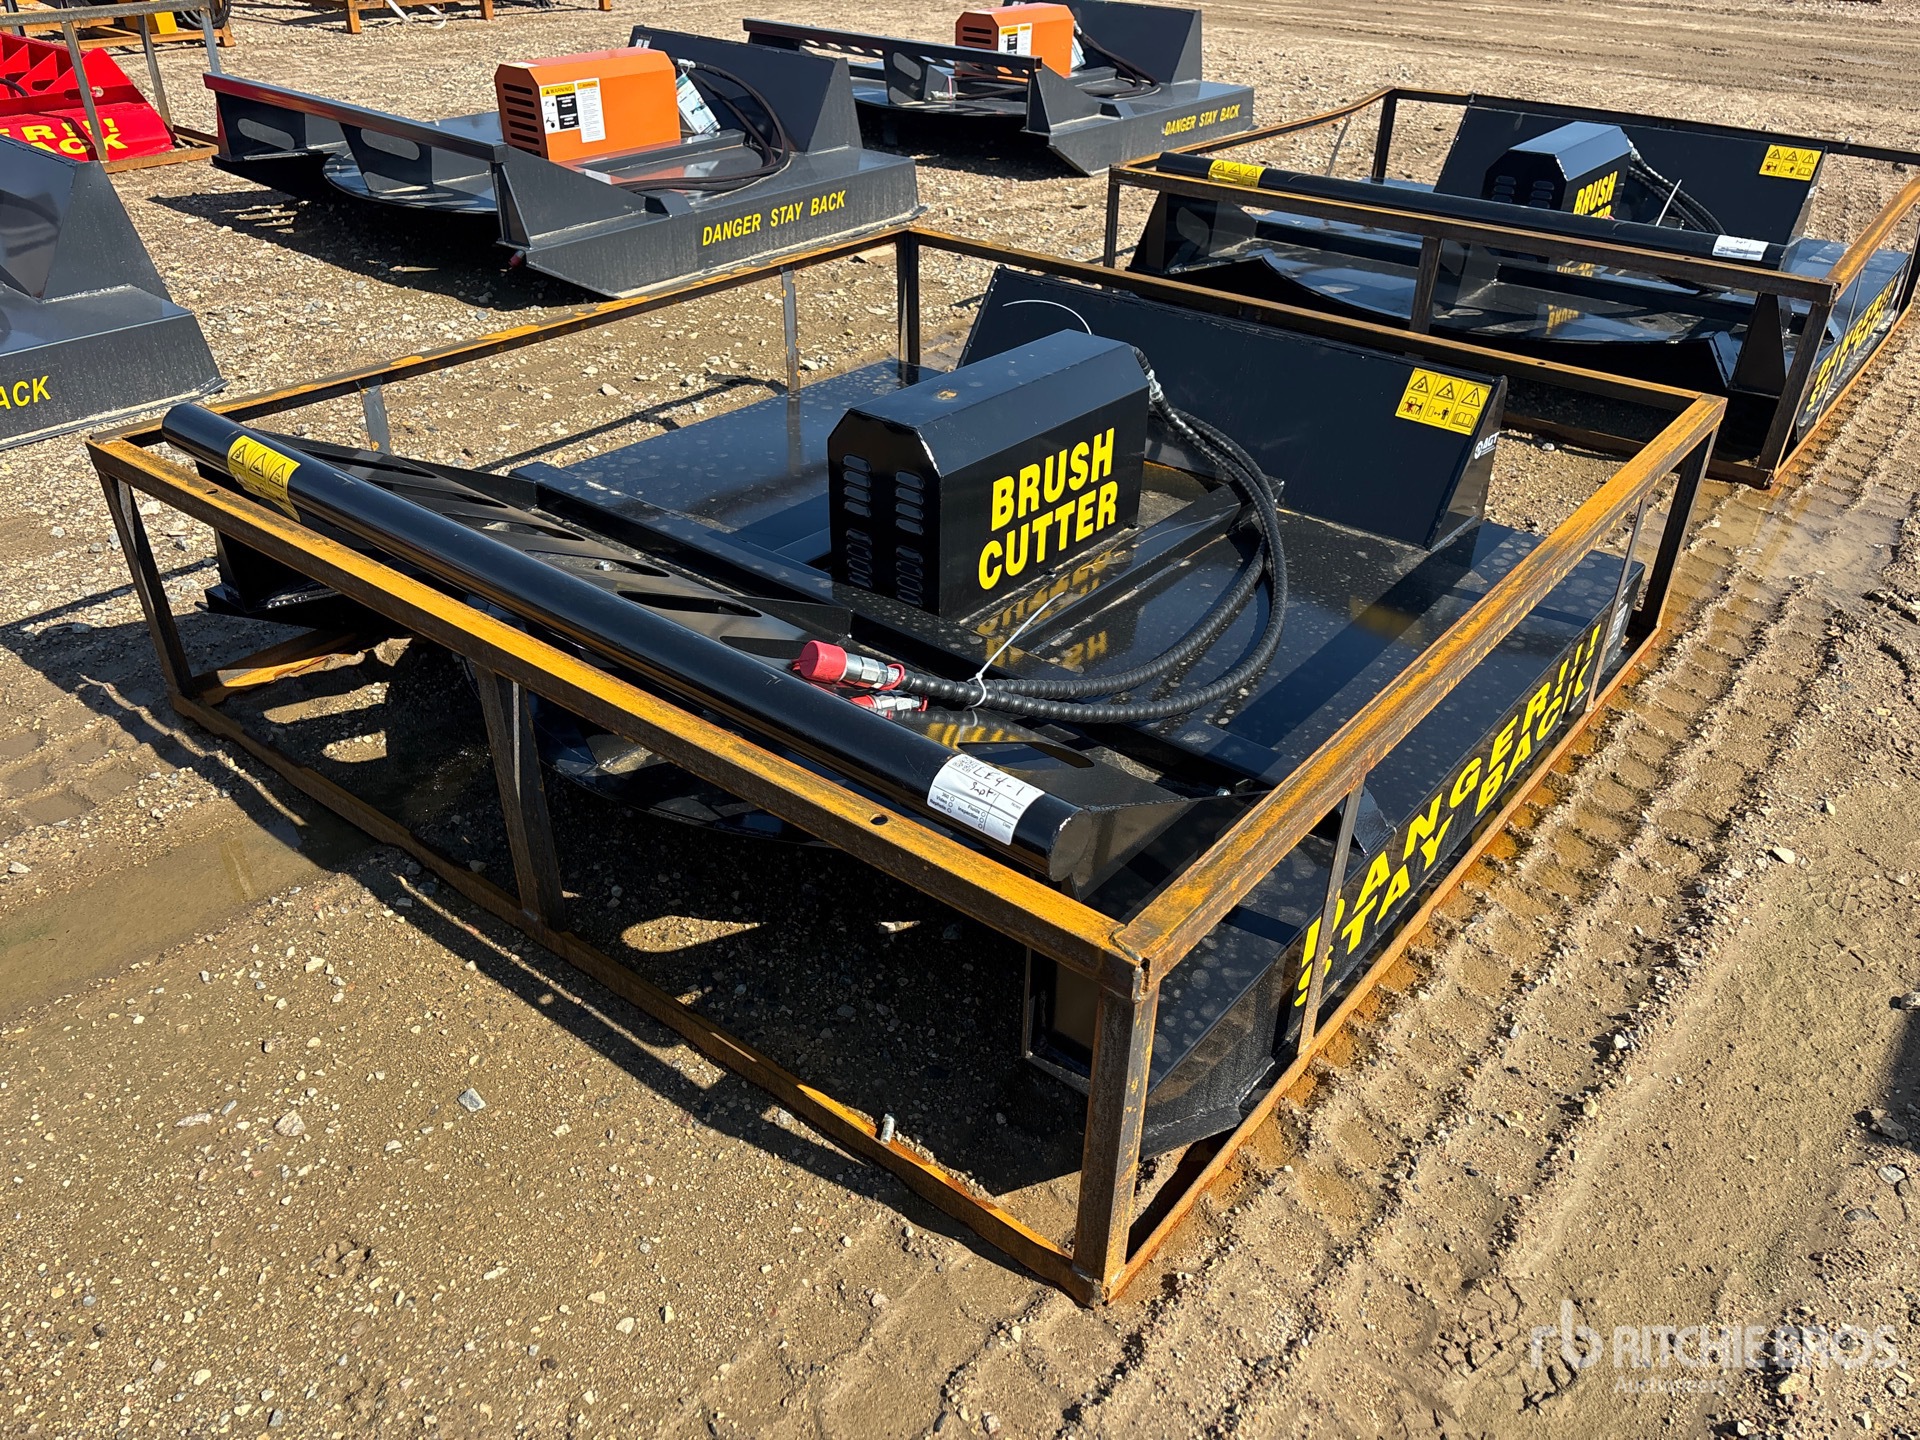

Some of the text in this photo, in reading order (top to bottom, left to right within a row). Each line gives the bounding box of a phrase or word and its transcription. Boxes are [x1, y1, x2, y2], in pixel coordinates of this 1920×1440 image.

[1164, 103, 1241, 137] DANGER STAY BACK
[702, 189, 847, 247] DANGER STAY BACK
[1573, 170, 1618, 216] BRUSH
[1806, 348, 1849, 412] STY
[991, 427, 1115, 532] BRUSH
[978, 480, 1118, 590] CUTTER
[1475, 660, 1592, 817] BACK
